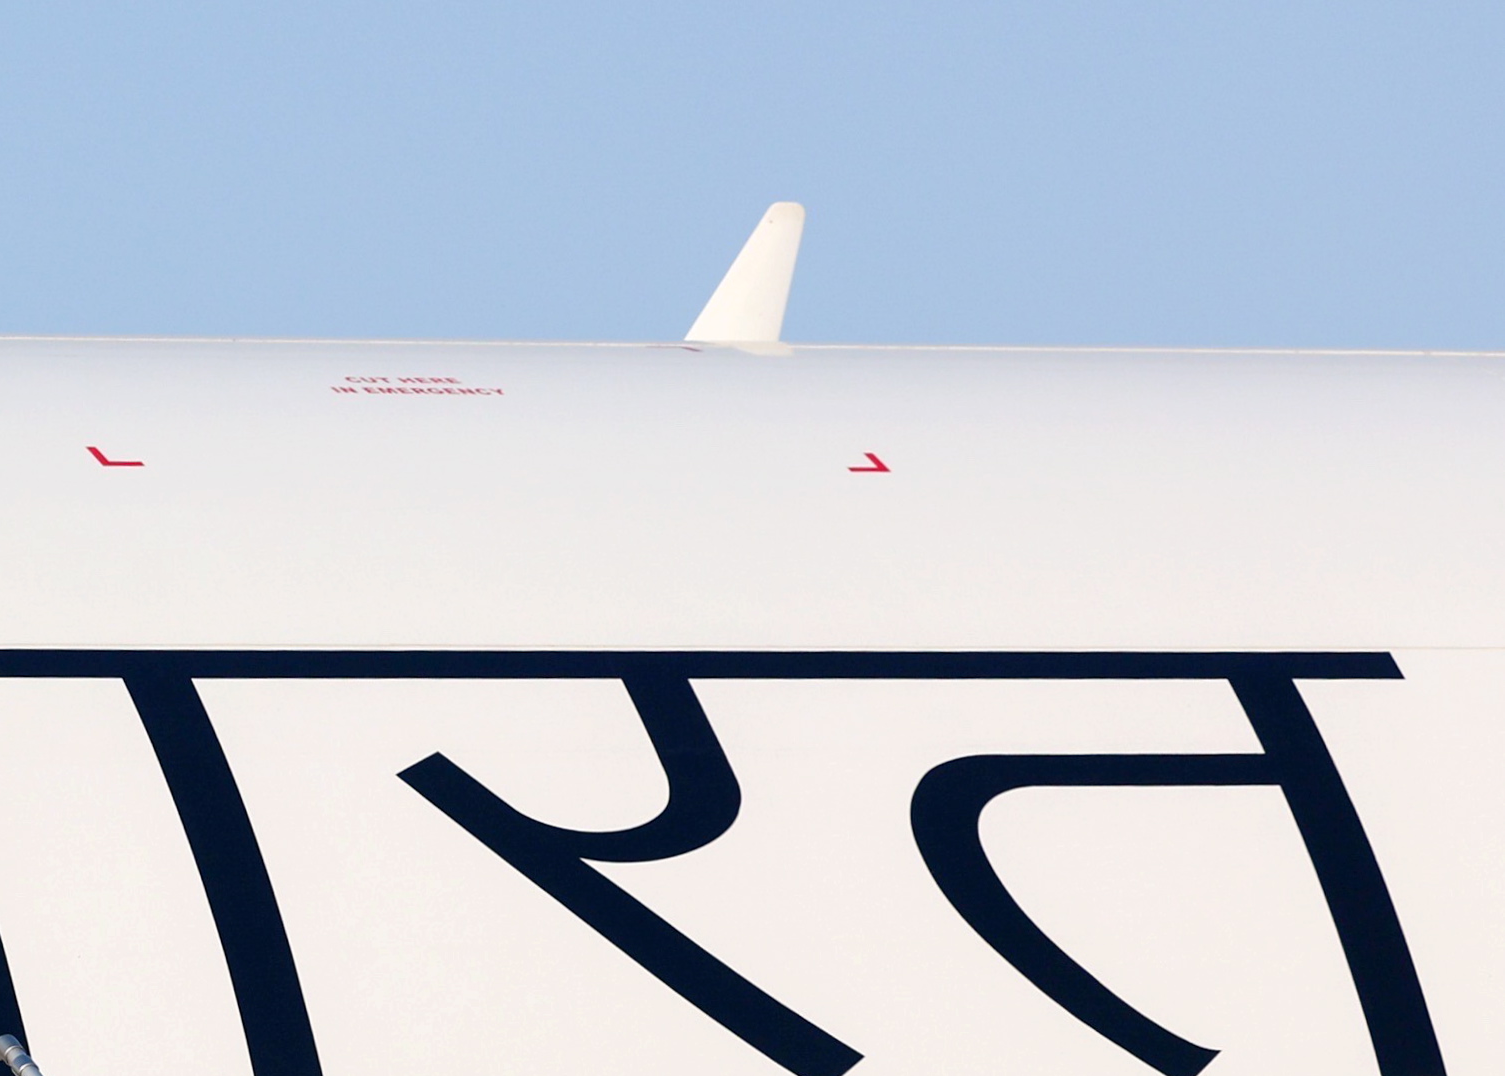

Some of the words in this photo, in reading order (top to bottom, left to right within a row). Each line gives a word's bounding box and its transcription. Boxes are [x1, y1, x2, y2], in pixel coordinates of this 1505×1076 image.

[344, 376, 390, 384] CUT
[330, 386, 358, 394] IN
[363, 386, 505, 396] EMERGENCY
